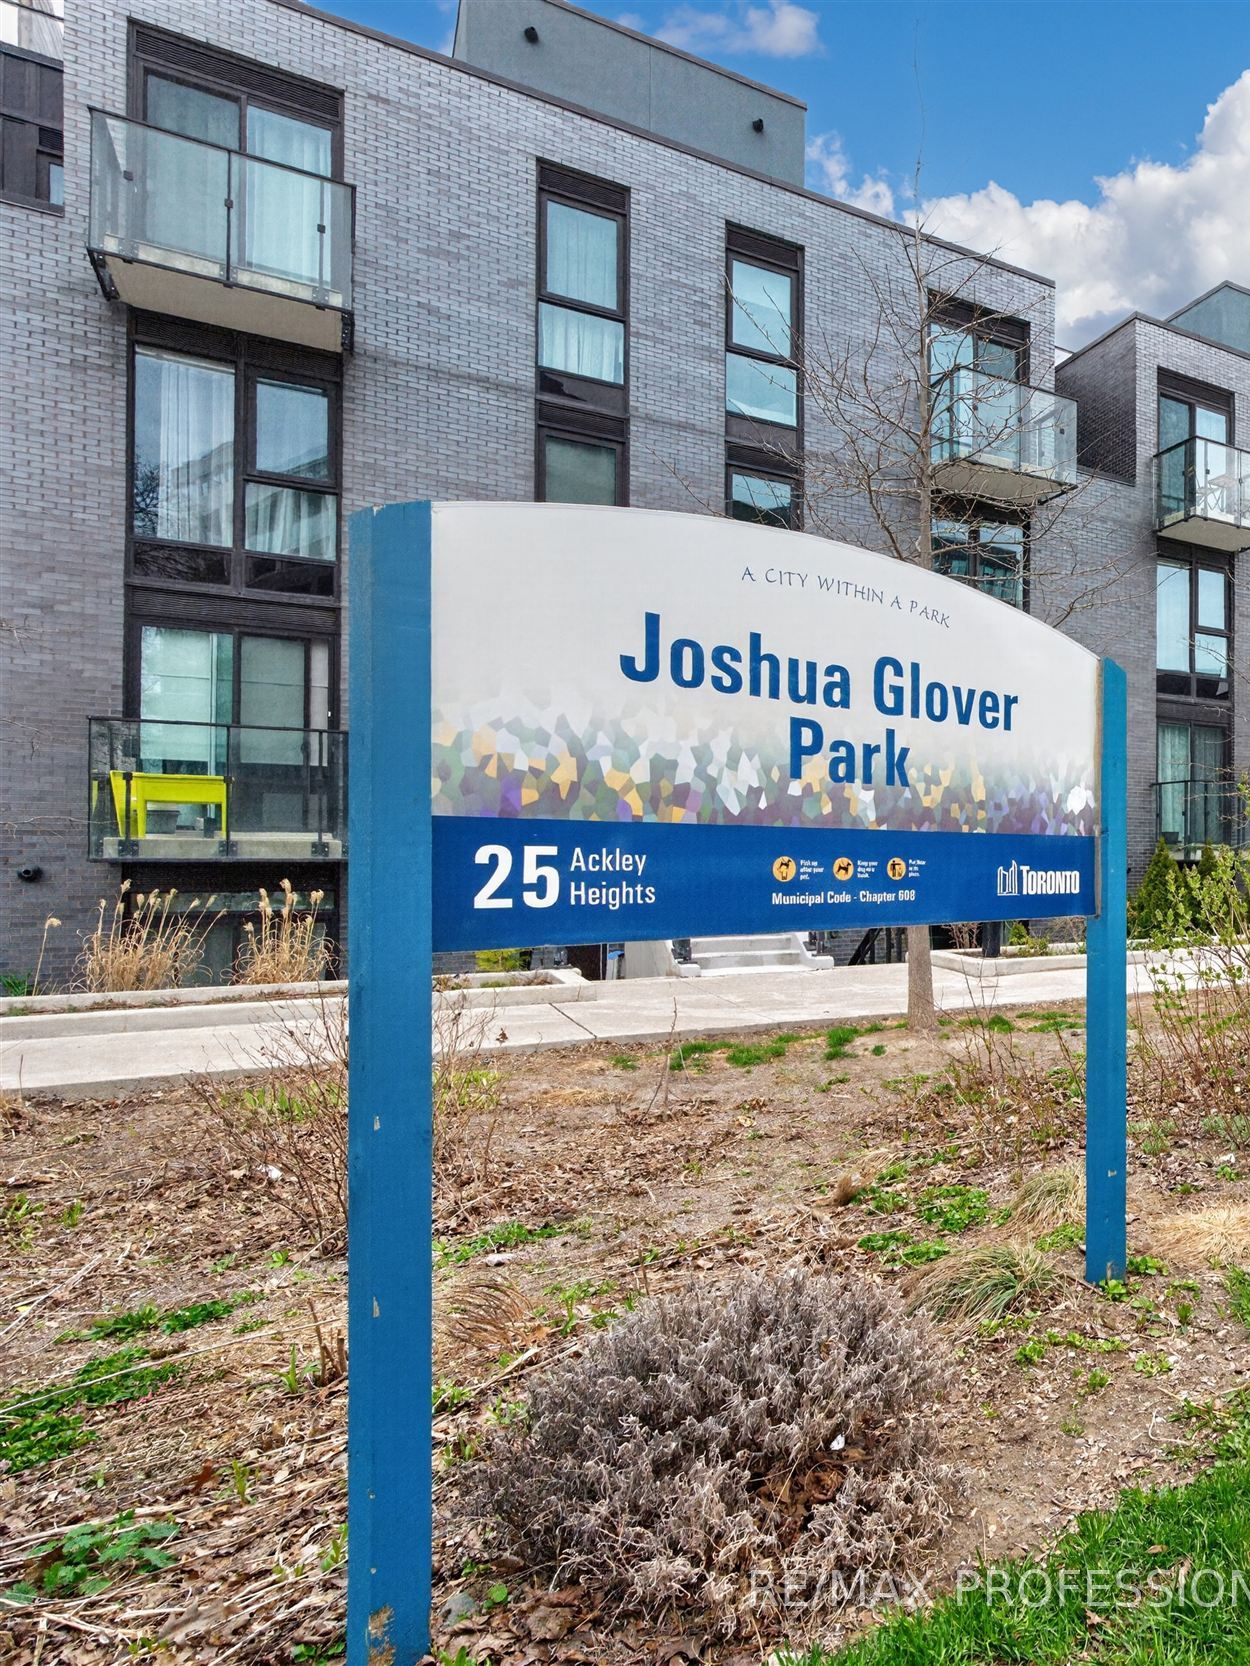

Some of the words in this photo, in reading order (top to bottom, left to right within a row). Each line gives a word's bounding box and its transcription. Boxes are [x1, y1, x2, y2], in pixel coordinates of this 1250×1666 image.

[741, 566, 757, 582] A
[765, 568, 808, 588] CITY
[817, 575, 884, 605] WITHIN
[890, 595, 903, 610] A
[910, 600, 950, 628] PARK
[619, 610, 851, 710] Joshua
[873, 655, 1019, 732] Glover
[789, 716, 911, 788] Park
[473, 844, 560, 909] 25
[570, 847, 647, 877] Ackley
[1019, 865, 1080, 895] TORONTO
[569, 881, 656, 911] Heights
[771, 892, 824, 906] Municipal
[827, 891, 852, 904] Code
[859, 890, 896, 904] Chapter
[898, 889, 916, 901] 608
